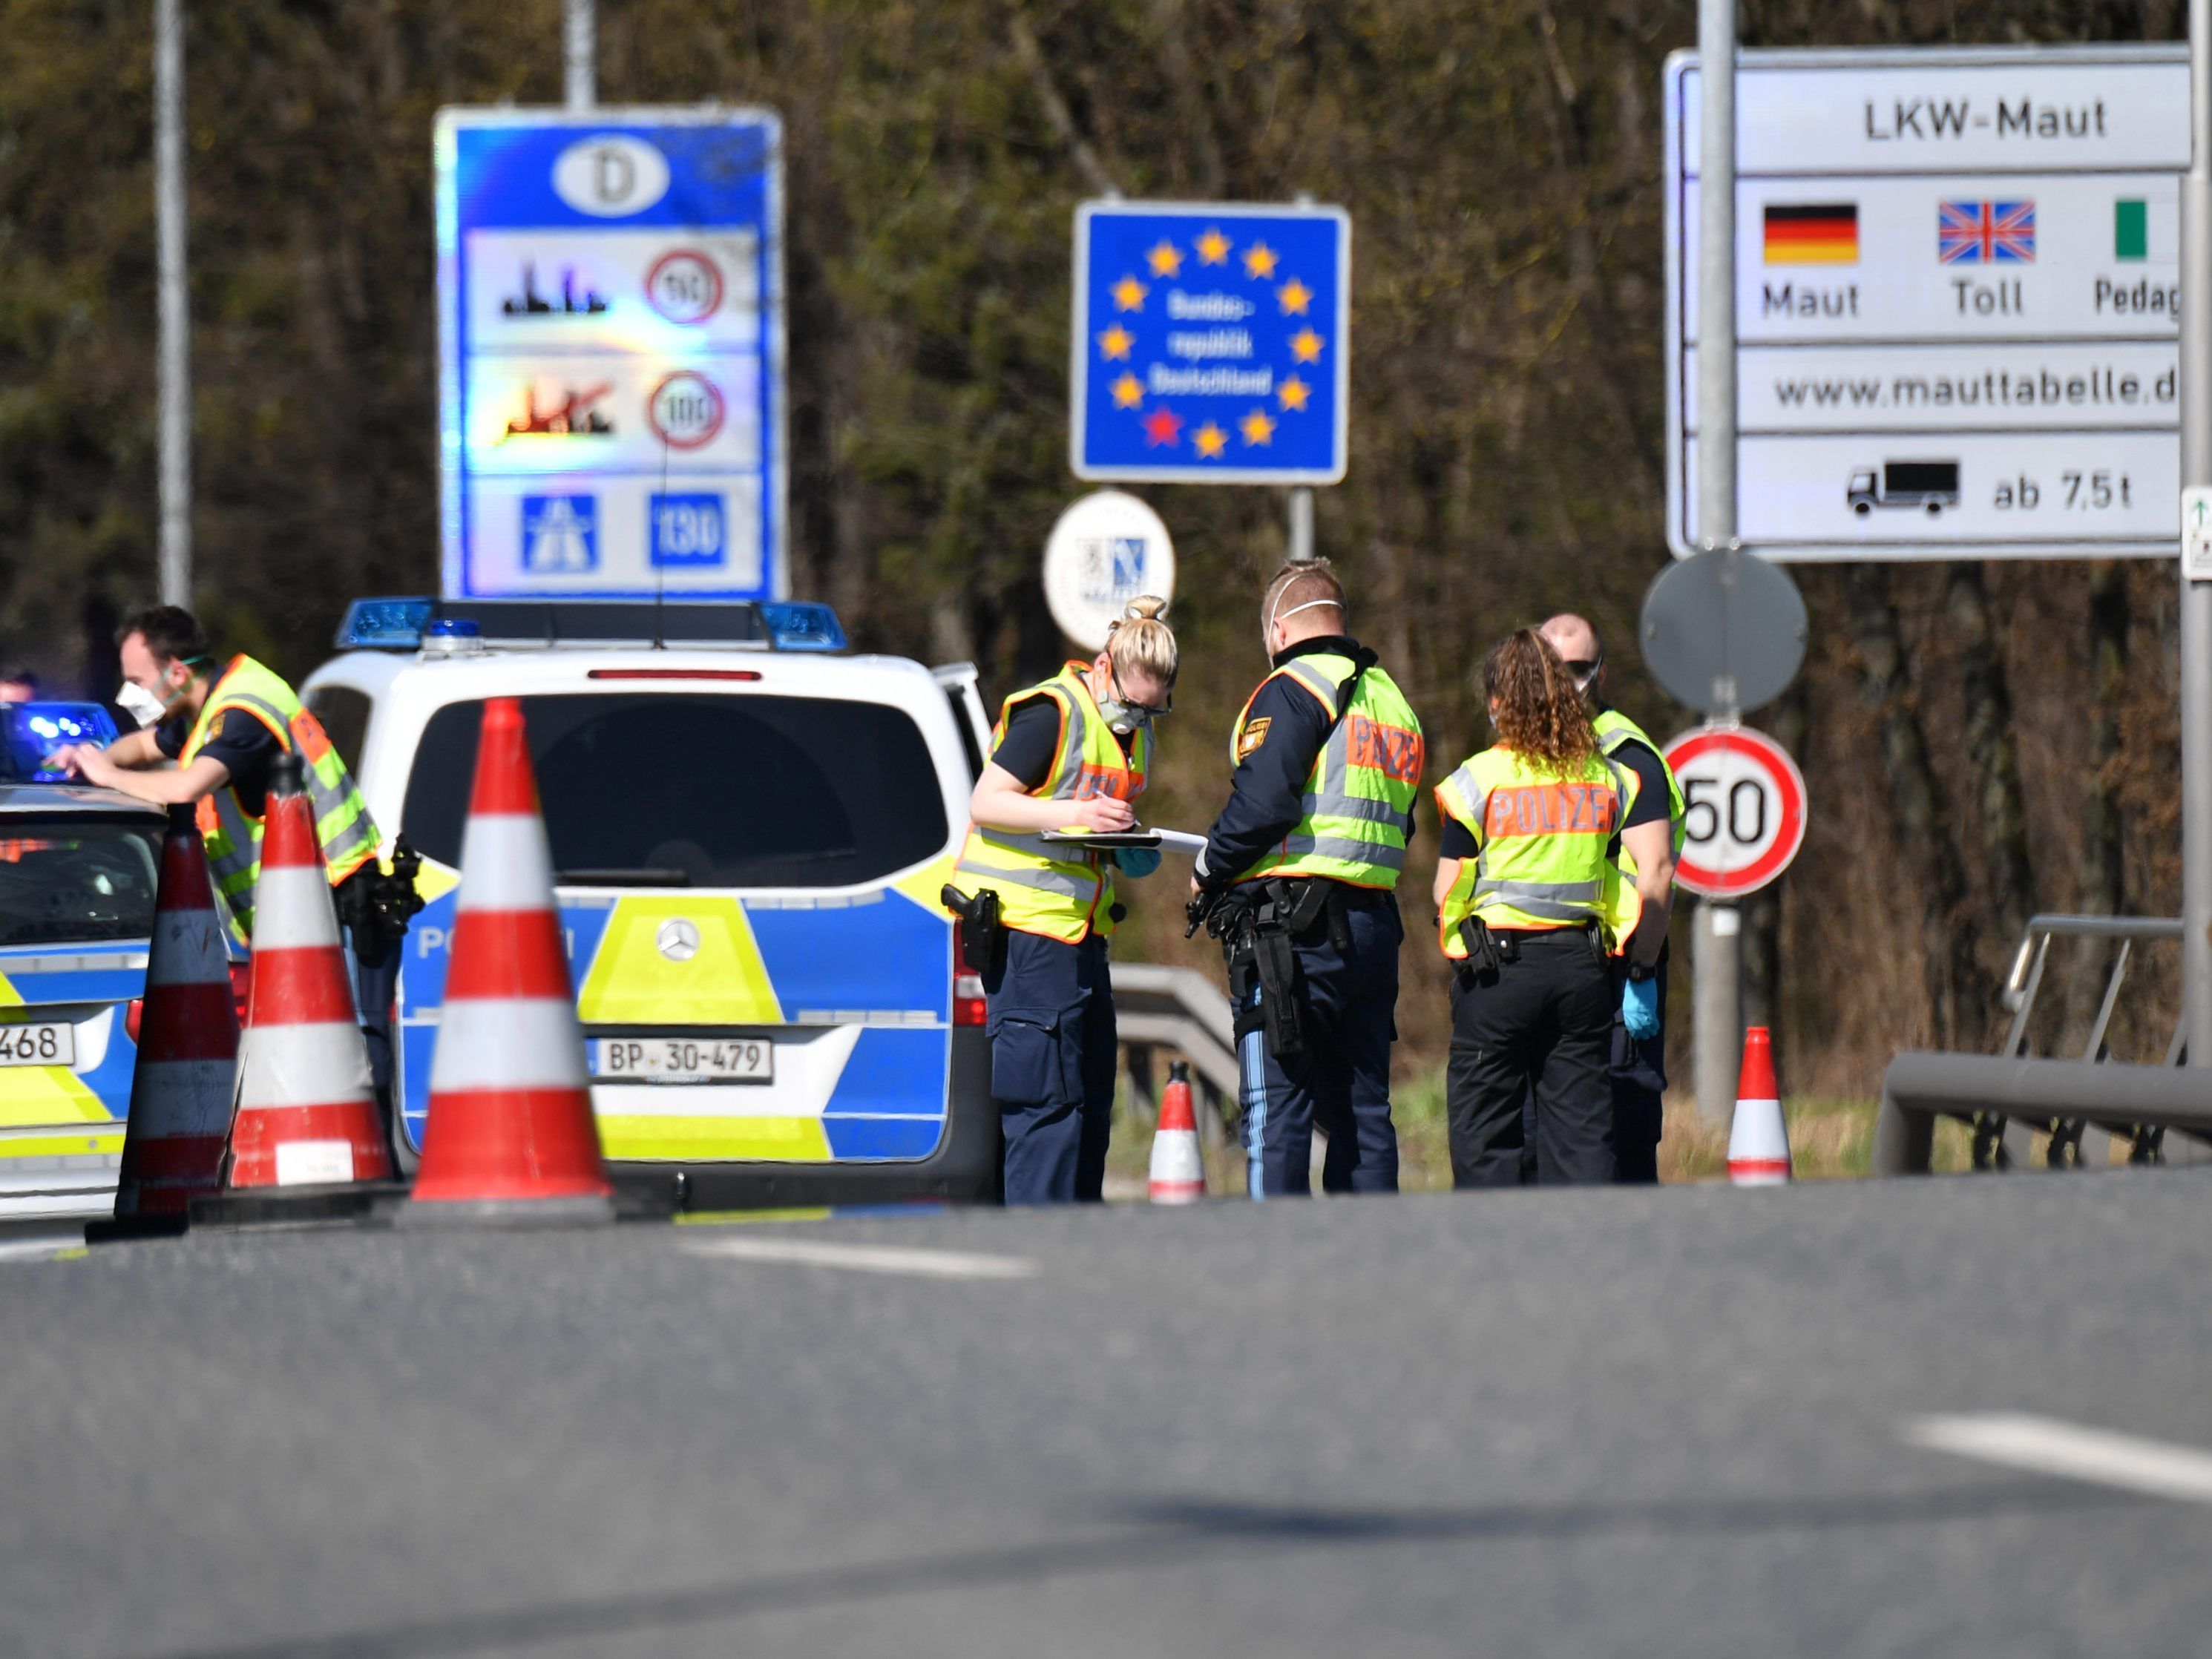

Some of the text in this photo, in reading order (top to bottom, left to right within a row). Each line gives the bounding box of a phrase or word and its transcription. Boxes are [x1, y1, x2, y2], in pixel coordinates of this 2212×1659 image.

[1864, 96, 2108, 140] LKW-Maut
[594, 146, 636, 204] D
[1762, 280, 1860, 318] Maut
[1952, 275, 2024, 316] Toll
[1775, 364, 2176, 407] www.mauttabelle.d
[1993, 473, 2041, 510] ab
[1684, 777, 1765, 843] 50
[609, 1042, 643, 1071] BP
[665, 1042, 761, 1072] 30-479
